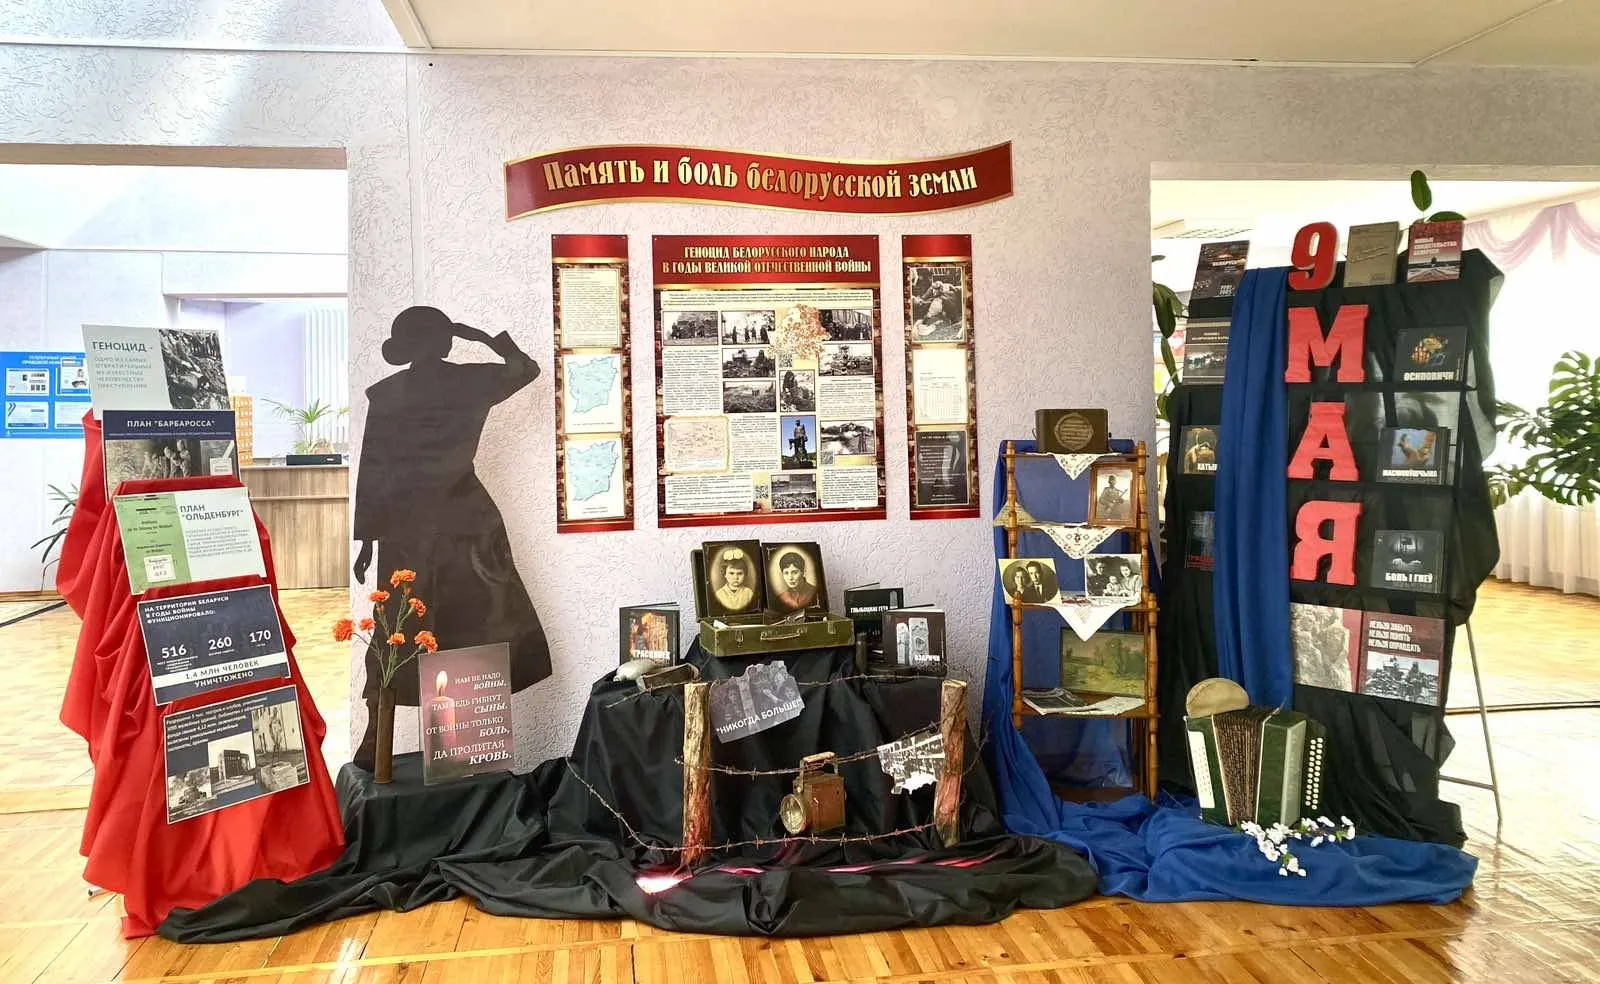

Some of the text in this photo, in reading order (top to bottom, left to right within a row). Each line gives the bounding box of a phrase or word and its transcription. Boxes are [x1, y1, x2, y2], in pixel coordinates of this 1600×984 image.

[543, 156, 978, 200] Память и боль белорусской земли
[684, 246, 849, 259] ГЕНОЦИД БЕЛОРУССКОГО НАРОДА
[1288, 221, 1338, 291] 9
[662, 260, 871, 273] В ГОДЫ ВЕЛИКОЙ ОТЕЧЕСТВЕННОЙ ВОЙНЫ
[92, 341, 147, 352] ГЕНОЦИД
[180, 504, 206, 513] ПЛАН
[181, 509, 244, 521] "ОЛЬДЕНБУРГ"
[1385, 572, 1408, 582] БОЛЬ
[155, 601, 197, 611] ТЕРРИТОРИИ
[198, 596, 230, 605] БЕЛАРУСИ
[151, 609, 171, 618] ГОДЫ
[172, 606, 197, 615] ВОЙНЫ
[161, 630, 271, 659] 516 260 170
[200, 668, 220, 677] МЛН
[222, 660, 259, 675] ЧЕЛОВЕК
[194, 671, 254, 688] УНИЧТОЖЕНО
[455, 677, 470, 685] НАМ
[481, 671, 501, 680] НАДО
[474, 679, 507, 690] ВОЙНЫ.
[432, 703, 449, 711] ТАМ
[471, 694, 502, 705] ГИБНУТ
[474, 702, 508, 714] СЫНЫ.
[426, 716, 503, 735] ОТ ВОЙНЫ ТОЛЬКО
[716, 714, 760, 734] "НИКОГДА
[479, 726, 510, 737] БОЛЬ,
[434, 739, 505, 760] ДА ПРОЛИТАЯ
[469, 750, 512, 765] КРОВЬ.
